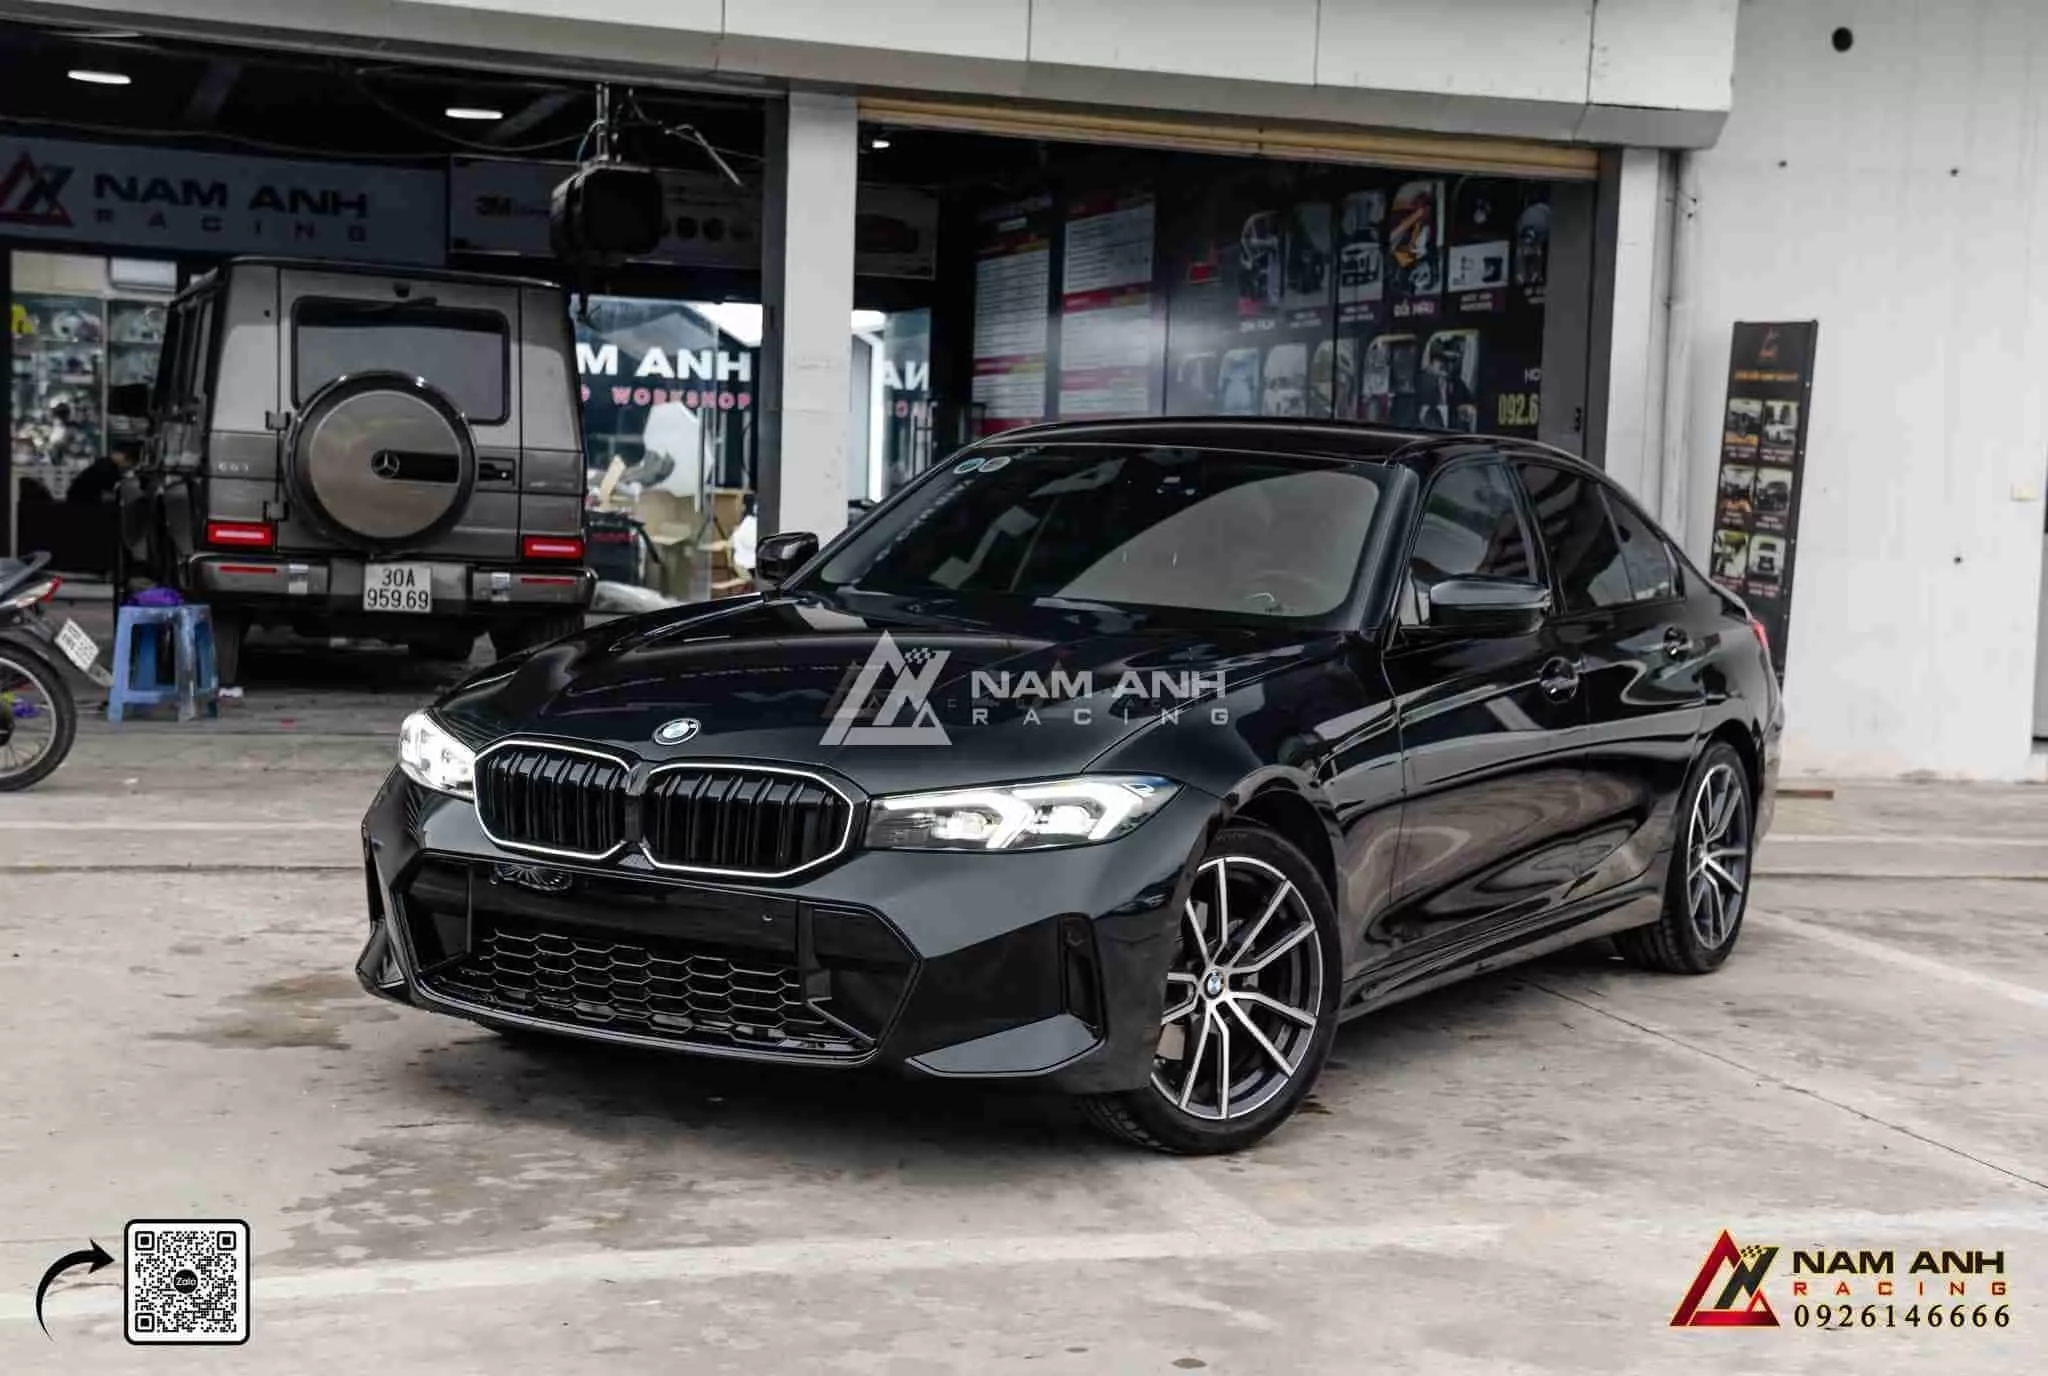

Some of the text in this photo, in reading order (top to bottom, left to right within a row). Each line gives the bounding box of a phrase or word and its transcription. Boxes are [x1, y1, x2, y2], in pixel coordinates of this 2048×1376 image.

[93, 173, 369, 220] NAM ANH
[94, 208, 367, 243] RACING
[634, 346, 752, 382] ANH
[611, 386, 751, 410] WORKSHOP
[382, 567, 415, 587] 30A
[367, 587, 429, 609] 959.69
